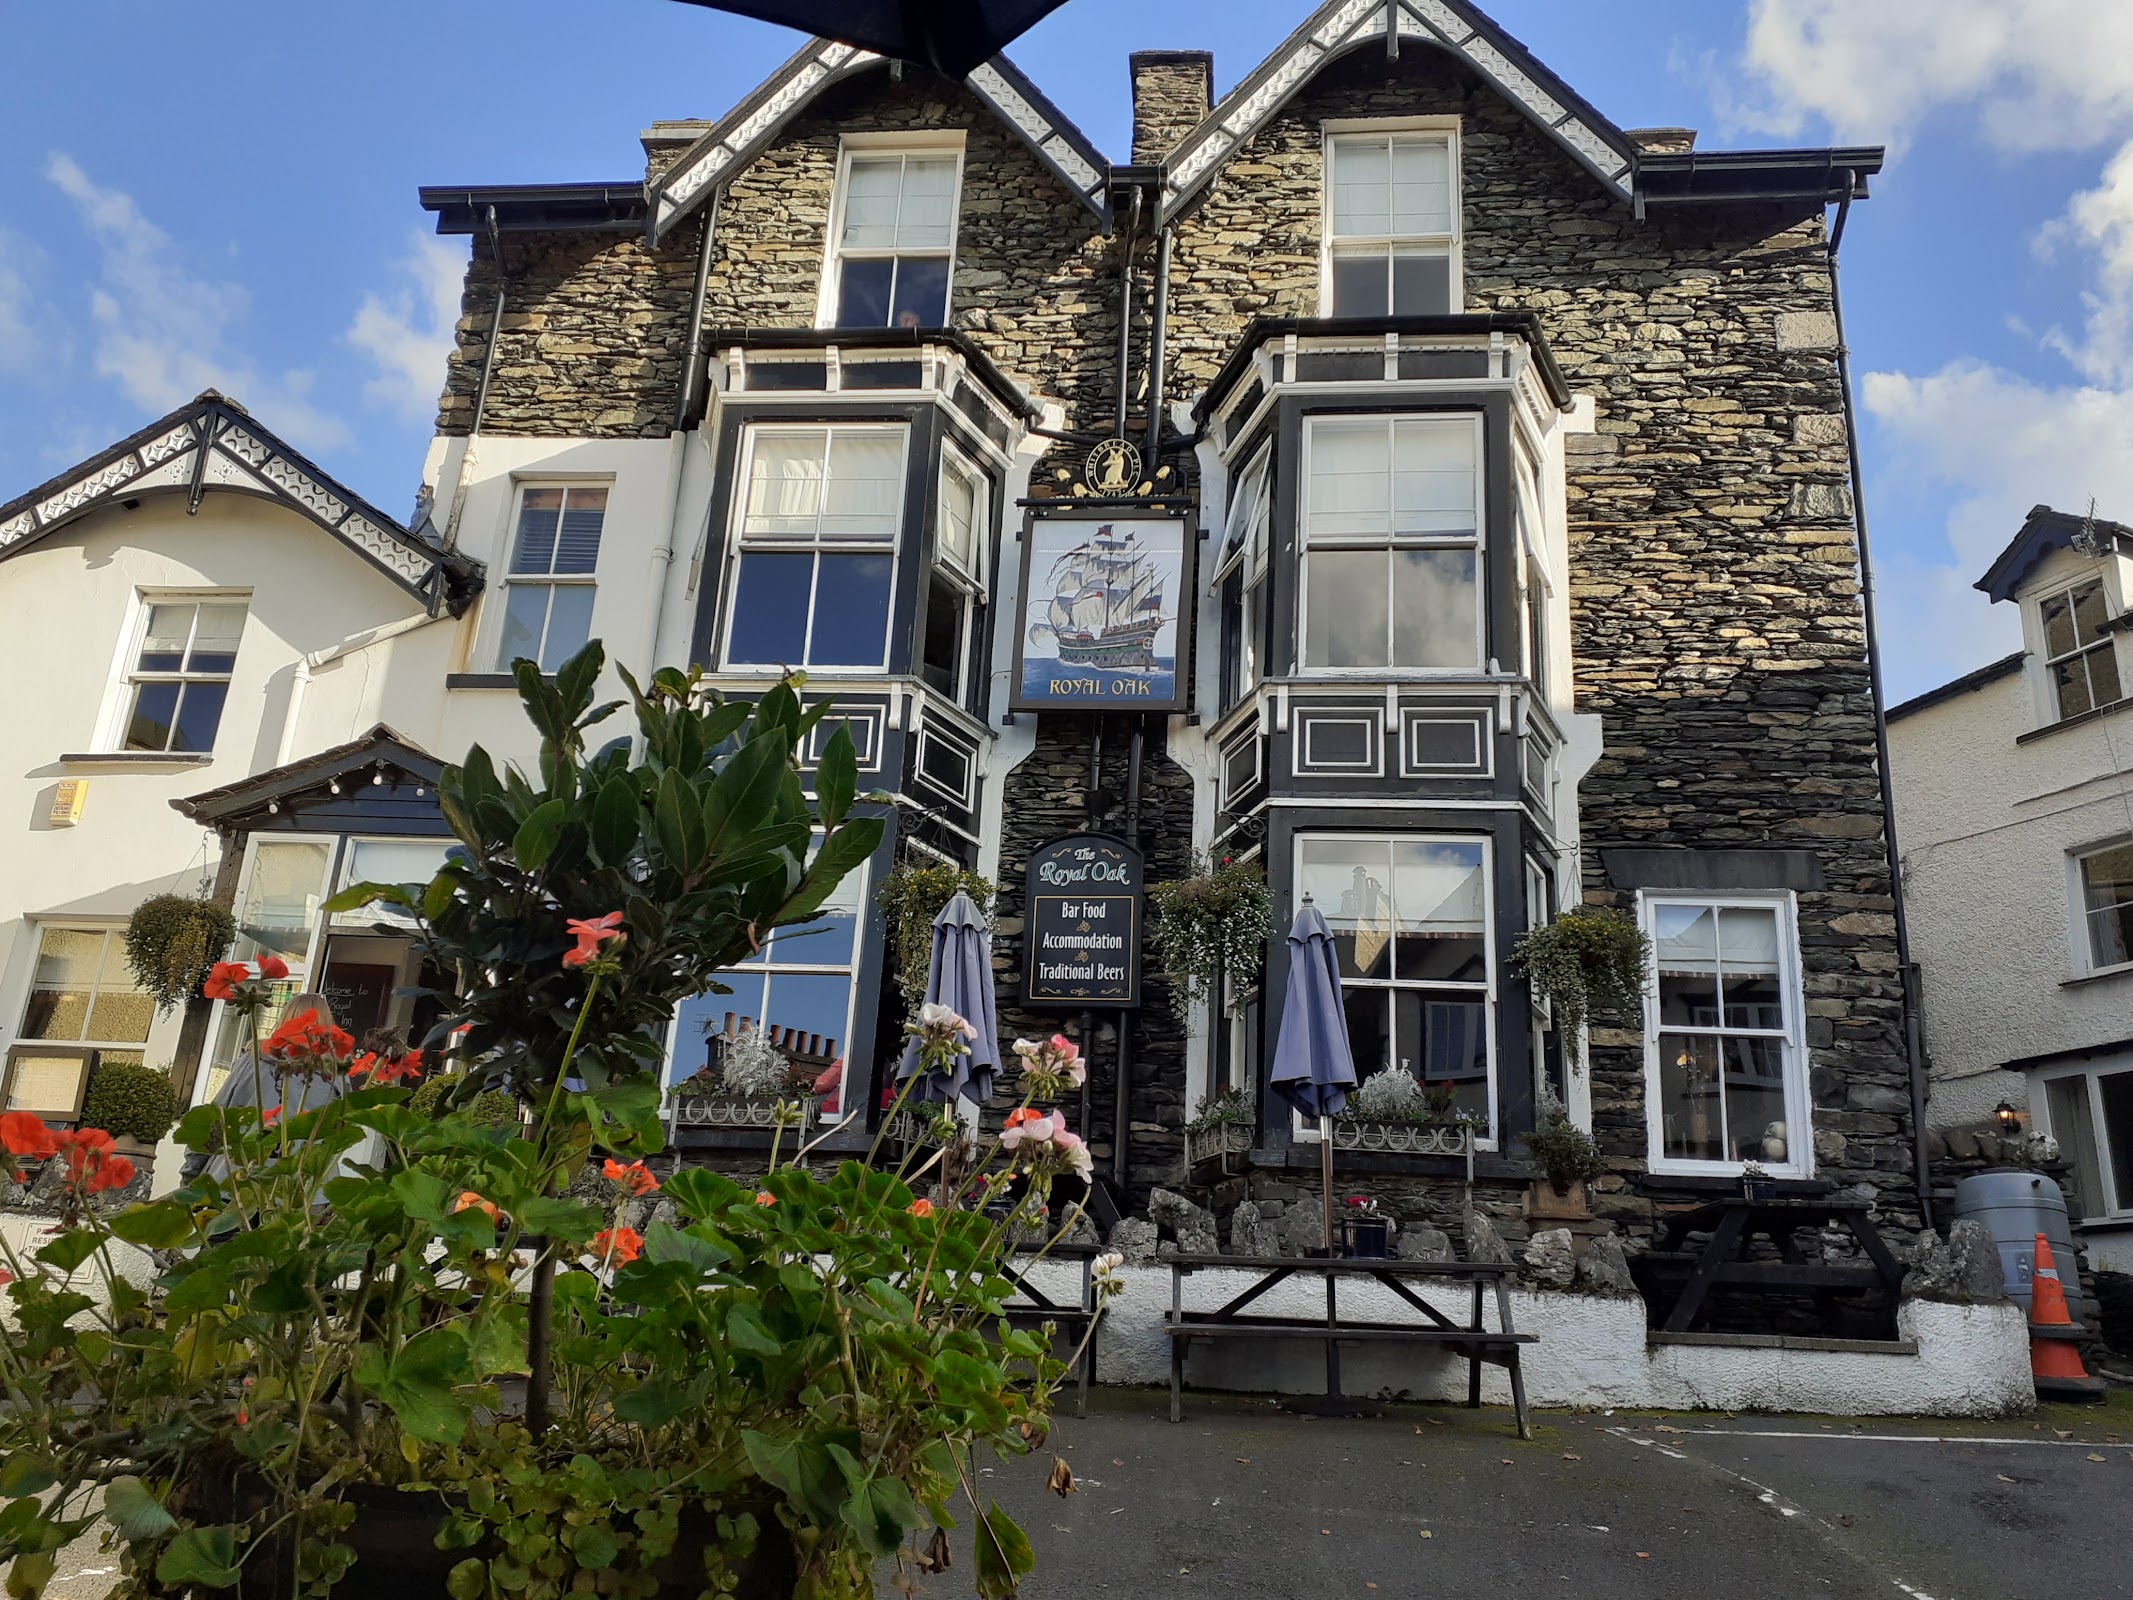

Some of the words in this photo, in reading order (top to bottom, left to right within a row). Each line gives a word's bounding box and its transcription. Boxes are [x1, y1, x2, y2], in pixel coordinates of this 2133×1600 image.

[1049, 678, 1106, 695] ROYAL
[1111, 678, 1152, 696] OAK
[1074, 847, 1096, 861] The
[1039, 861, 1091, 887] Royal
[1091, 861, 1131, 886] Oak
[1061, 901, 1080, 919] Bar
[1082, 901, 1106, 919] Food
[1042, 931, 1123, 949] Accommodation
[1039, 962, 1094, 980] Traditional
[1097, 963, 1125, 981] Beers
[358, 983, 369, 995] to
[328, 997, 352, 1015] Royal
[340, 1015, 353, 1027] Inn
